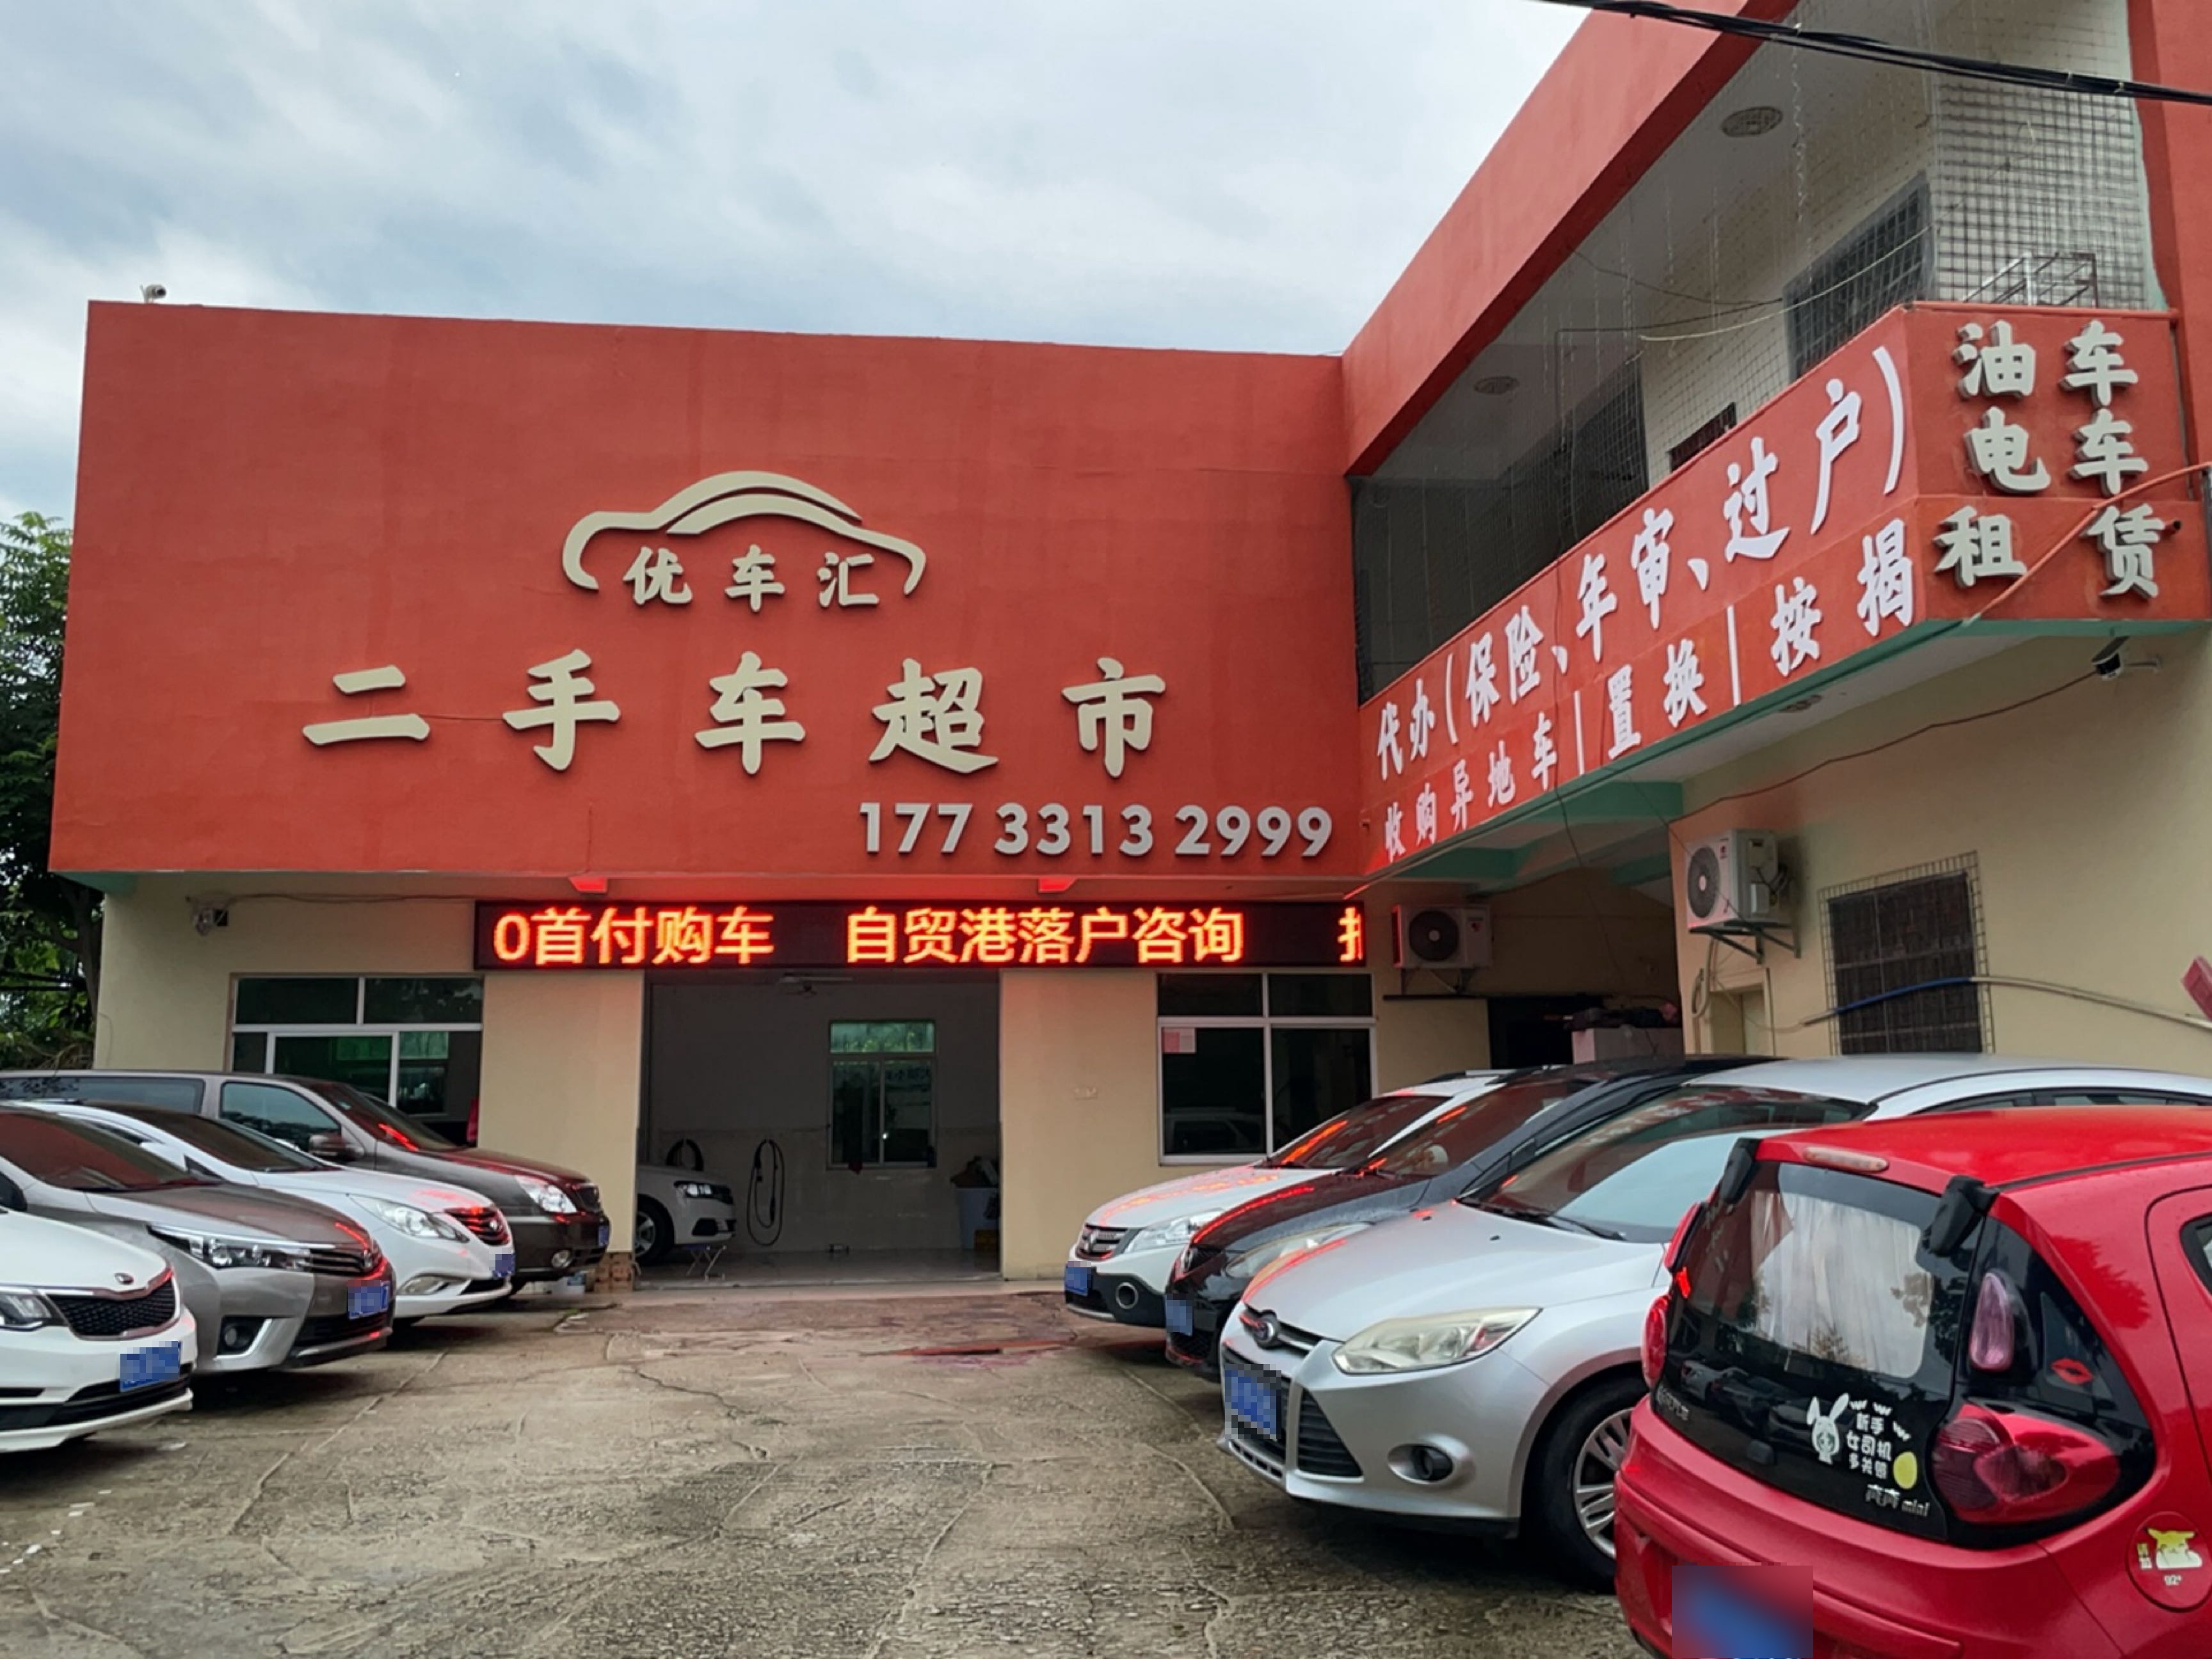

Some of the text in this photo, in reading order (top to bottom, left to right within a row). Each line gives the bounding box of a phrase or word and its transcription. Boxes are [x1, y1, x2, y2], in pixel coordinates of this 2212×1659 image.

[1953, 319, 2138, 406] 油车
[1965, 406, 2149, 495] 电车
[623, 544, 880, 612] 优车汇
[1933, 503, 2167, 599] 租赁
[302, 648, 1167, 777] 二手车超市
[859, 801, 1333, 857] 177 3313 2999
[493, 906, 1244, 966] 0首付购车 自贸港落户咨询
[1846, 1429, 1893, 1462] 女司机
